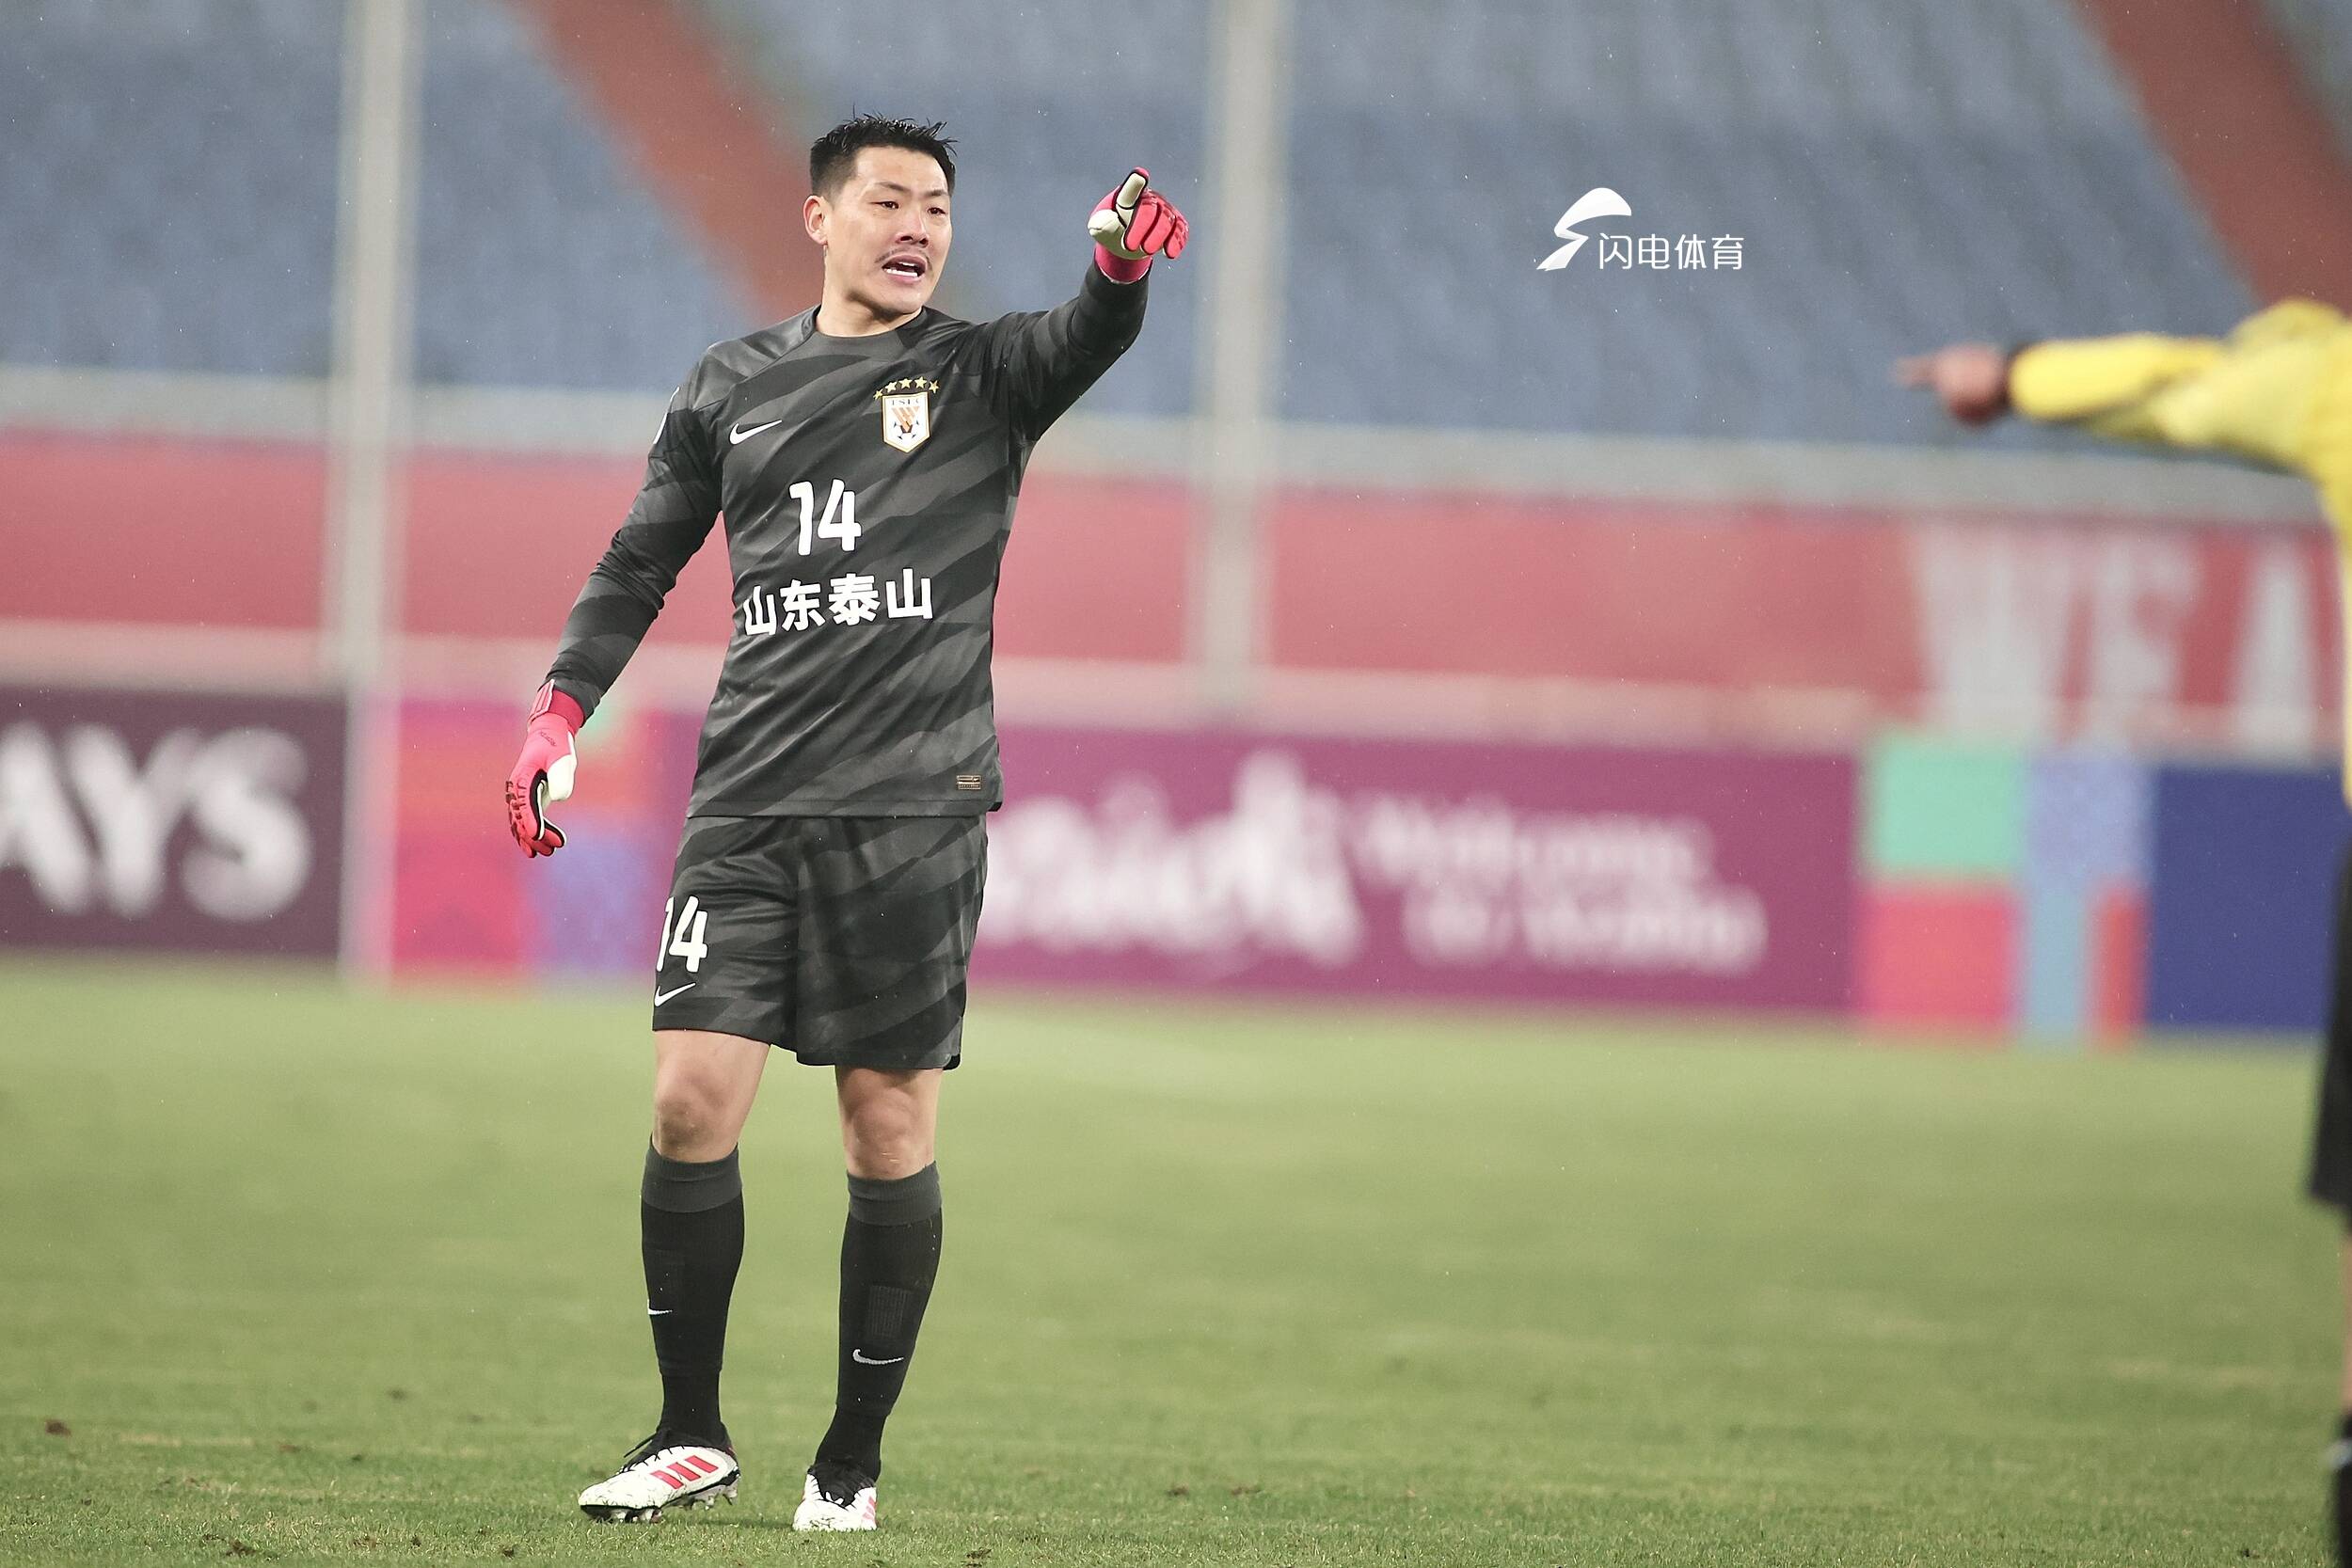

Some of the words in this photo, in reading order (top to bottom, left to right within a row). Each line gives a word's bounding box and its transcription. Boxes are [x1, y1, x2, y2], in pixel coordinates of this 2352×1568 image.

[789, 478, 863, 556] 14
[742, 568, 933, 636] 山东泰山
[656, 895, 708, 973] 14
